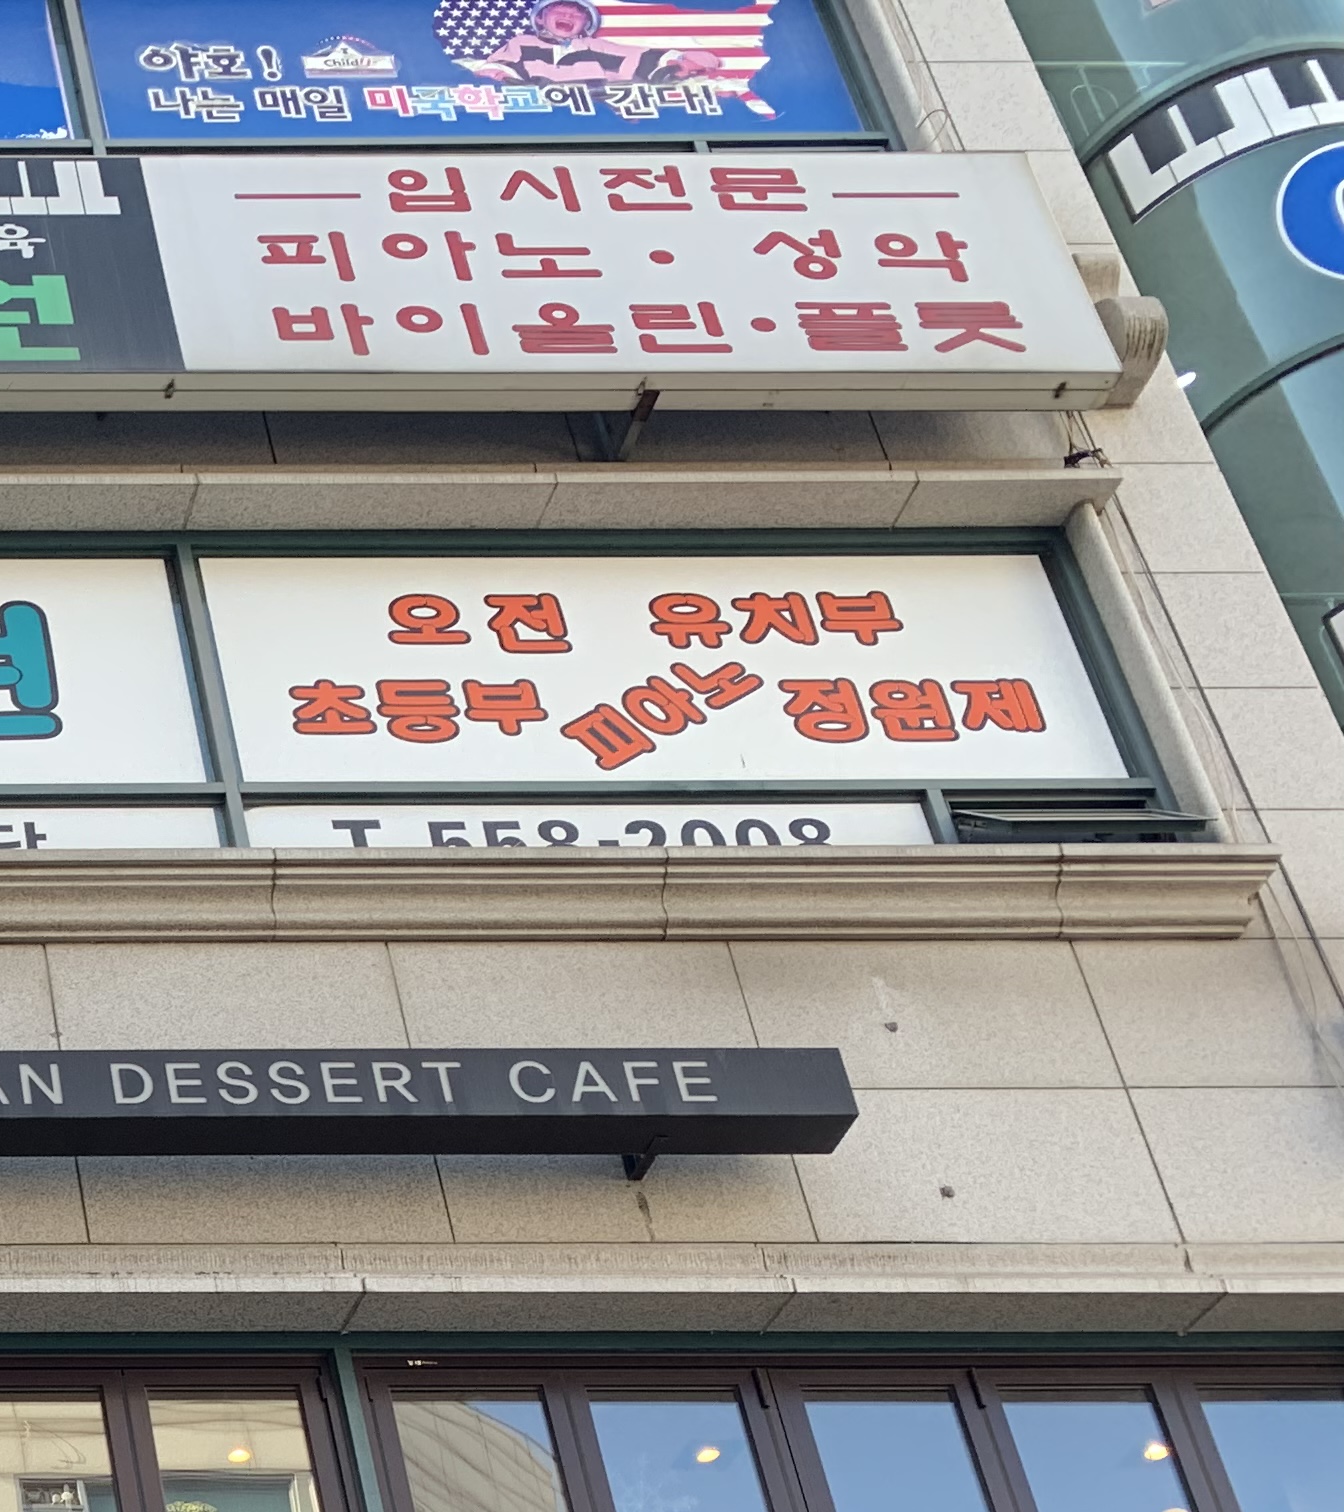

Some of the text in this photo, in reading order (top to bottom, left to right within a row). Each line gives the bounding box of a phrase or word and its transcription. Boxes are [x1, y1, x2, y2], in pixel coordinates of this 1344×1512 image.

[149, 84, 721, 122] 나는 매일 미국학교에 간다!
[387, 165, 808, 213] 입시전문
[388, 591, 903, 655] 오전 유치부
[288, 661, 1047, 771] 초등부 피아노 정원제
[112, 1060, 462, 1105] DESSERT
[509, 1059, 720, 1104] CAFE
